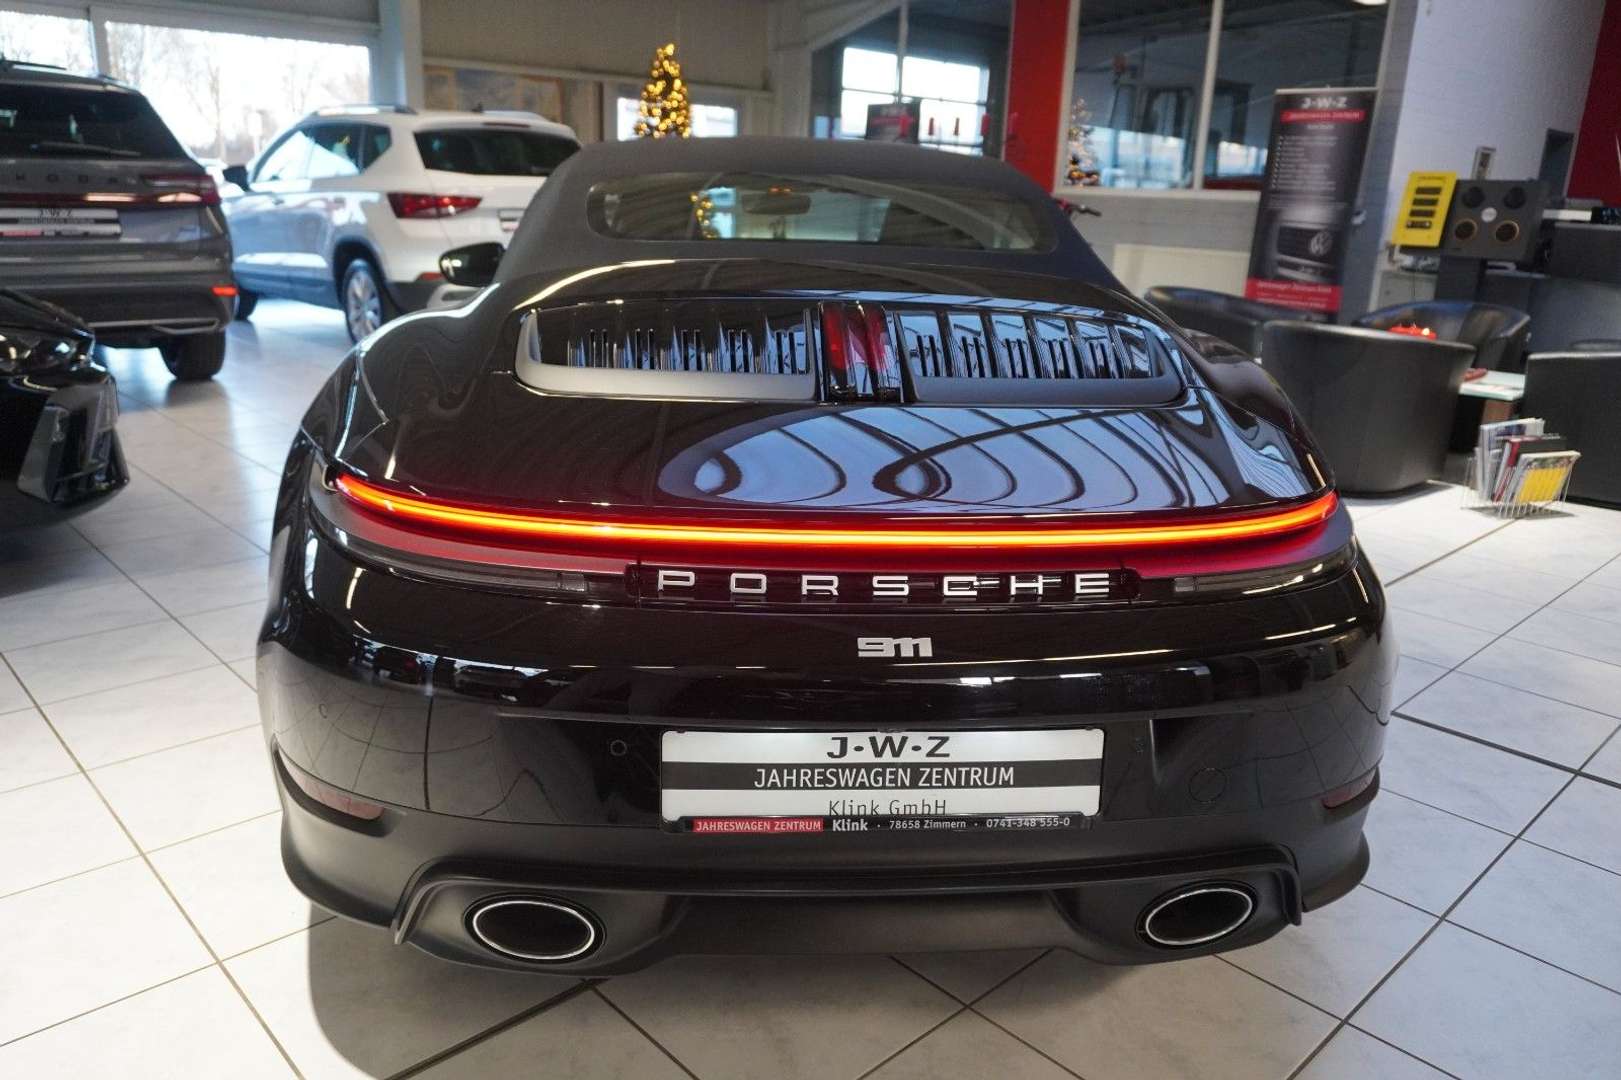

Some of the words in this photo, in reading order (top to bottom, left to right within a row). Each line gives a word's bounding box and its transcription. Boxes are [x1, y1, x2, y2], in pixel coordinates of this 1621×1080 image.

[658, 569, 1110, 596] PORSCHE
[857, 637, 933, 658] 911
[754, 767, 911, 788] JAHRESWAGEN
[918, 766, 1014, 787] ZENTRUM
[829, 800, 880, 816] Klink
[889, 799, 946, 815] GmbH
[696, 821, 770, 831] JAHRESWAGEN
[774, 821, 821, 831] ZENTRUM
[832, 819, 868, 832] Klink
[889, 820, 920, 829] 78658
[923, 818, 966, 829] Zimmern
[1040, 816, 1070, 827] 555-0
